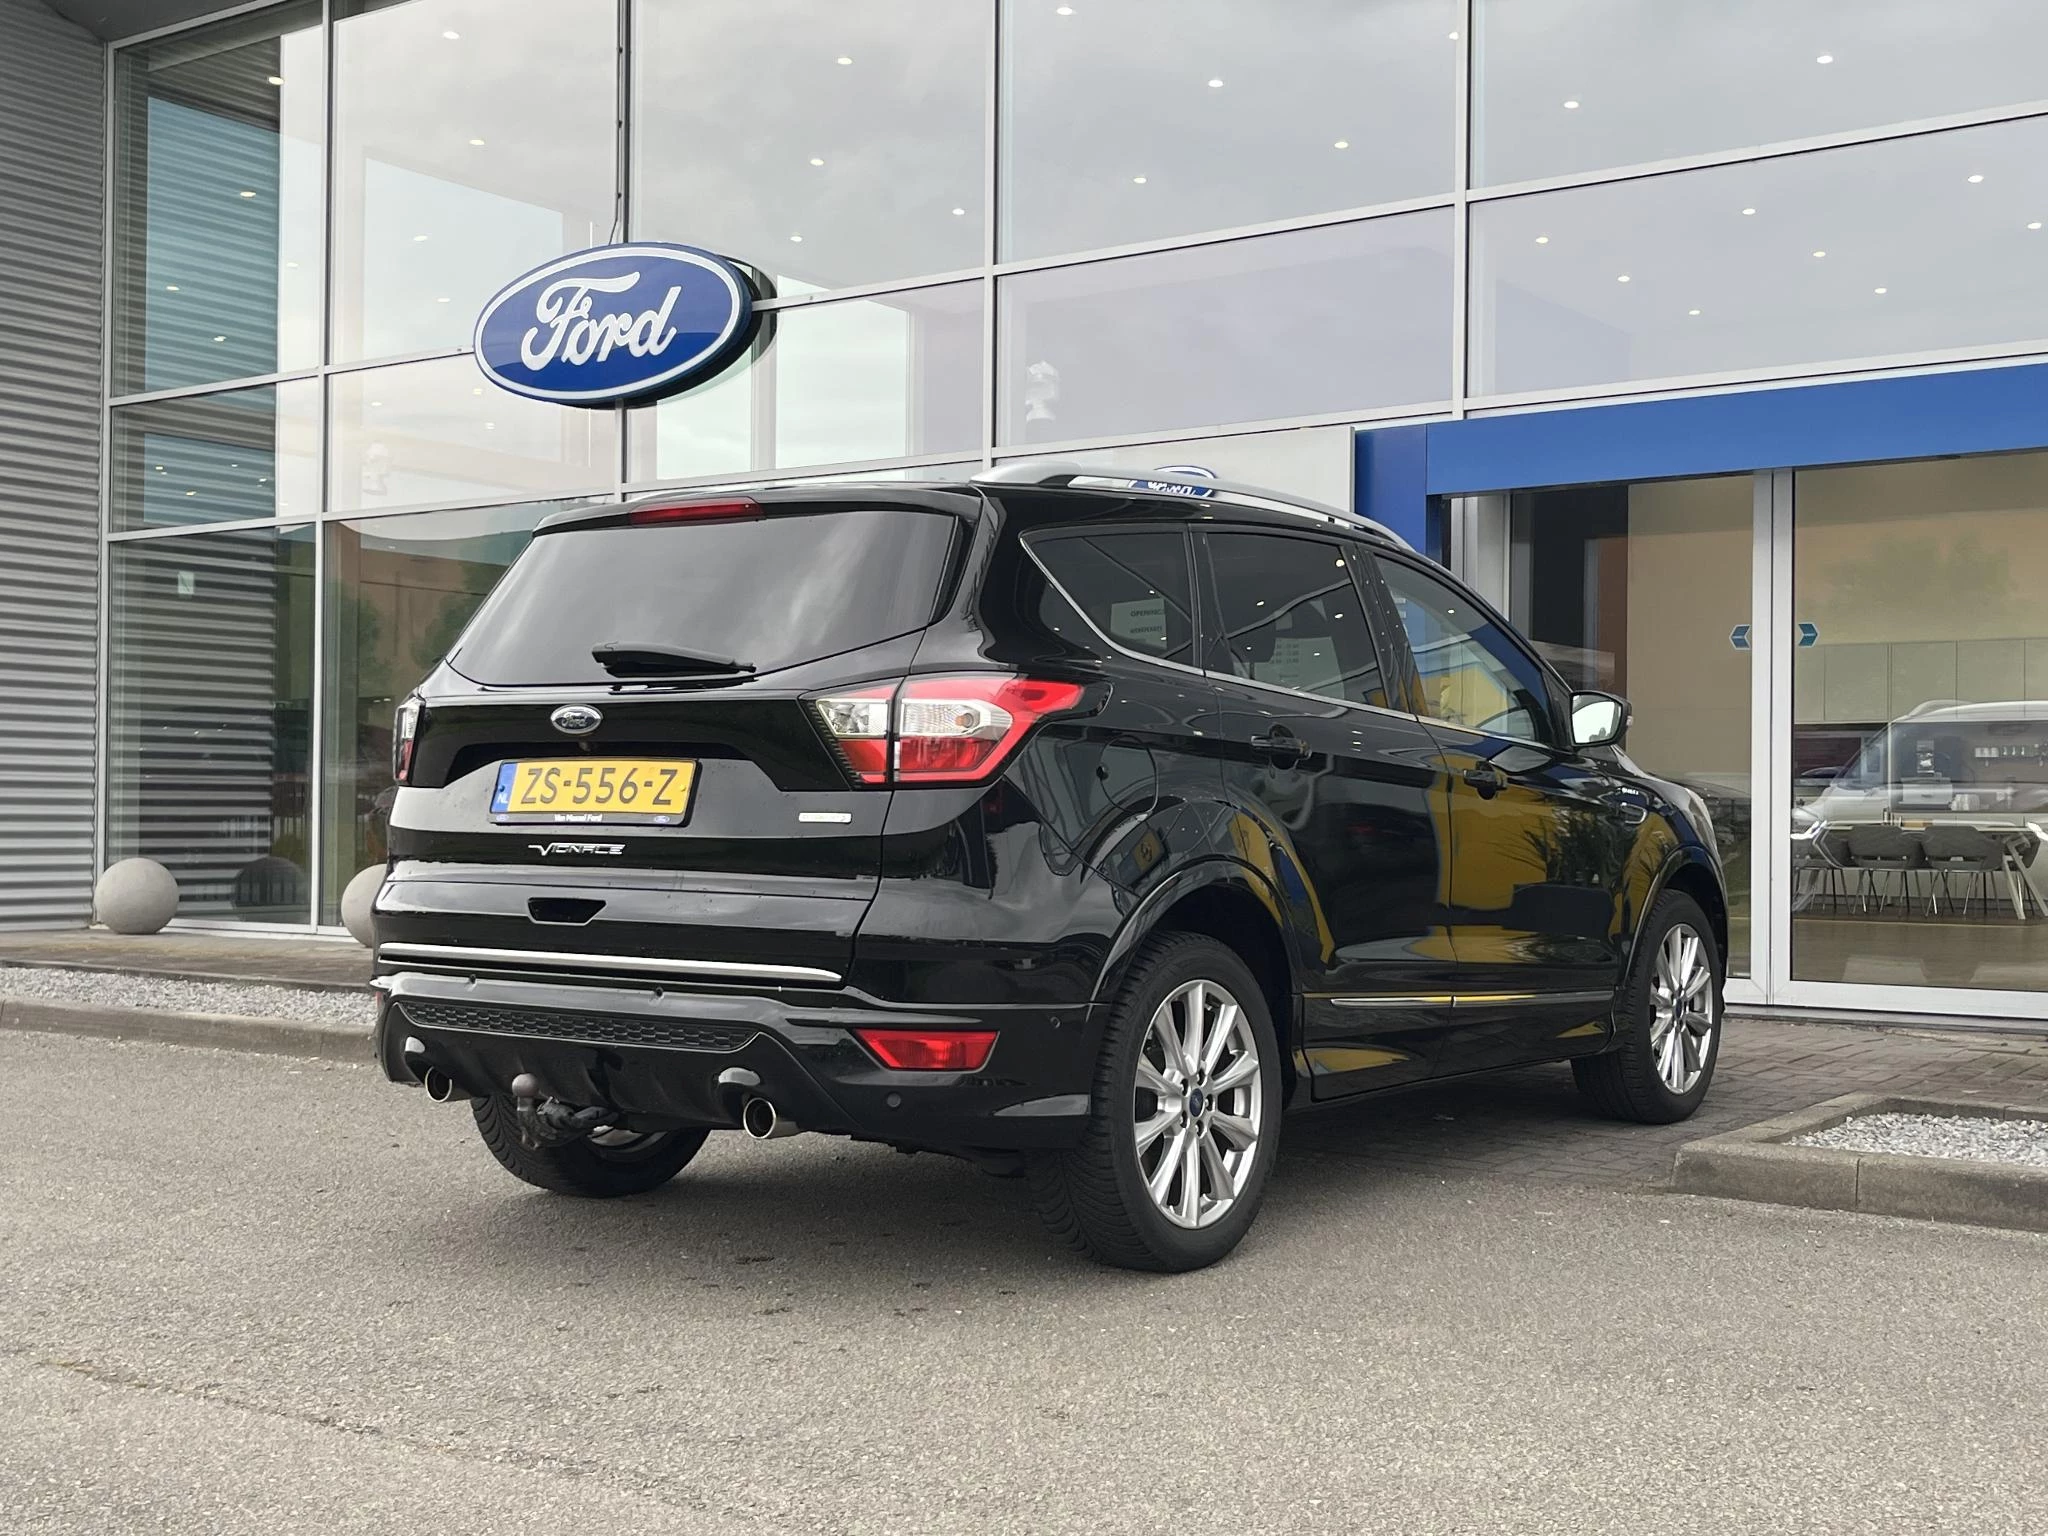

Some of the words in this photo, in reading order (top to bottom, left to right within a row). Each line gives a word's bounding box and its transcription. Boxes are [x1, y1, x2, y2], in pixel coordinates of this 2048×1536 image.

[520, 271, 681, 371] Ford
[496, 793, 509, 804] NL
[520, 767, 679, 806] ZS-556-Z
